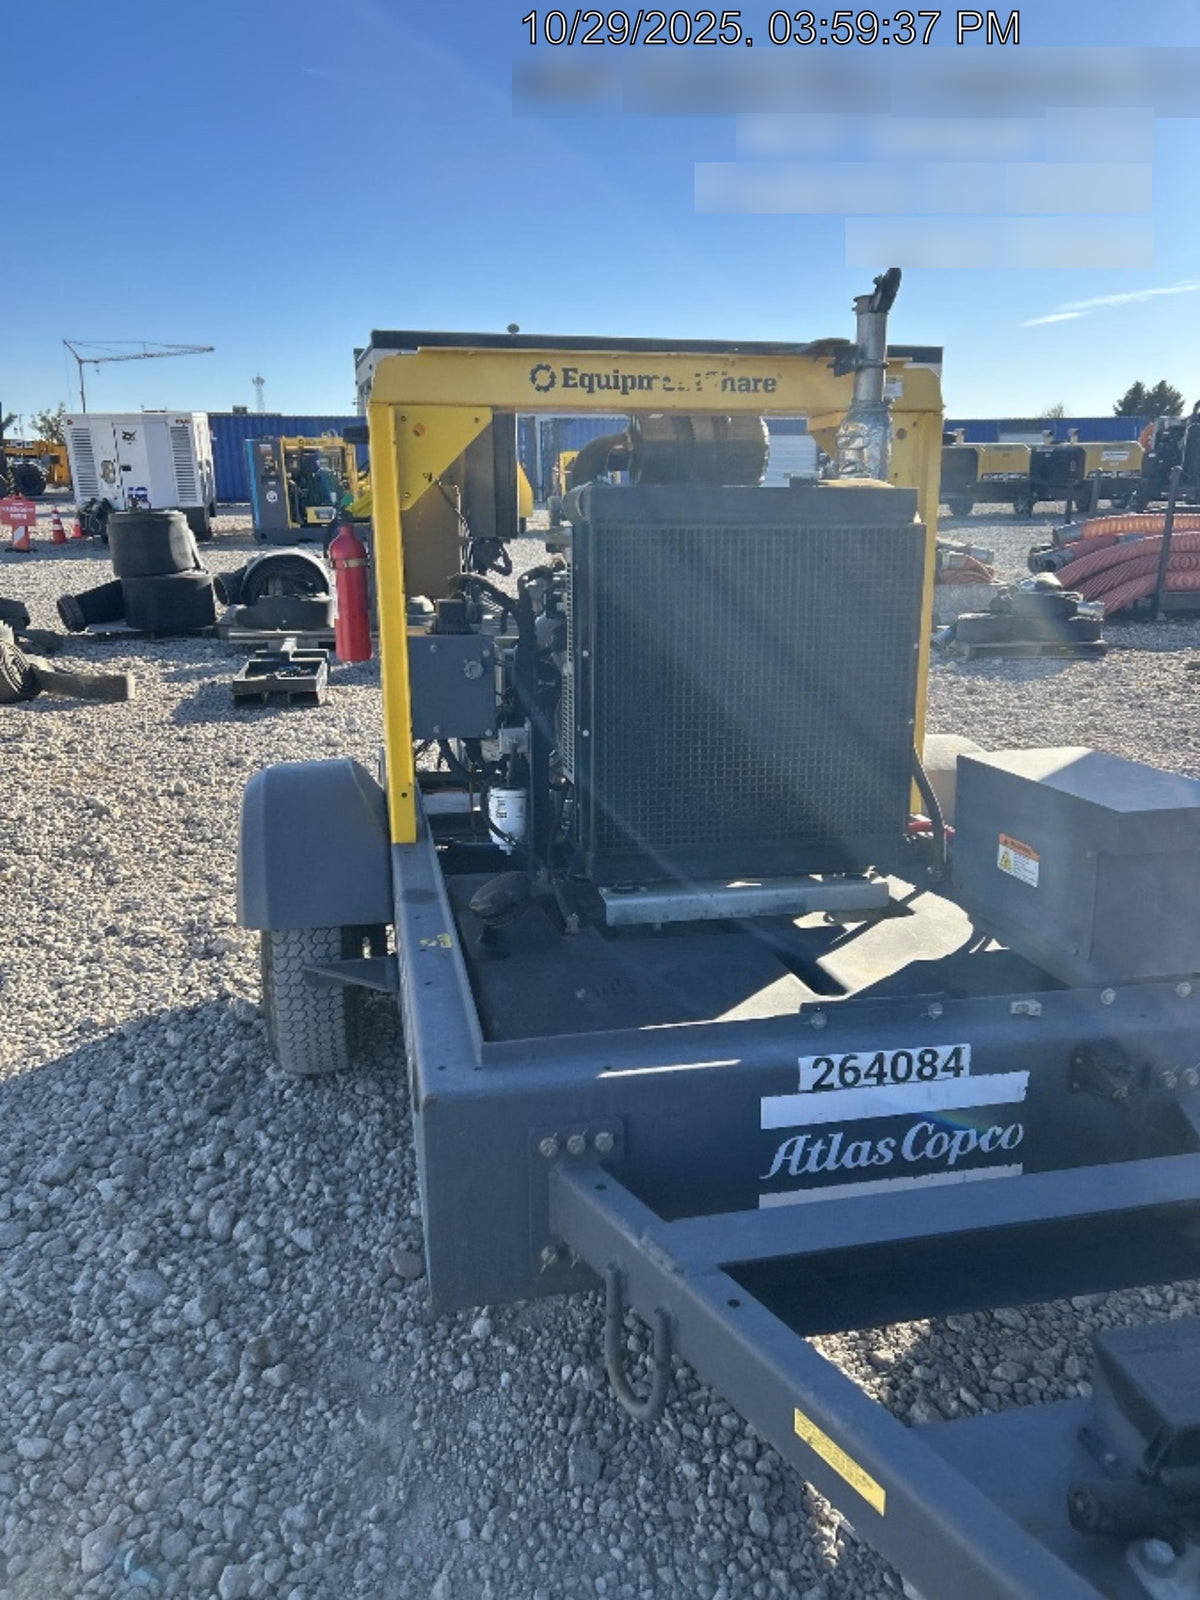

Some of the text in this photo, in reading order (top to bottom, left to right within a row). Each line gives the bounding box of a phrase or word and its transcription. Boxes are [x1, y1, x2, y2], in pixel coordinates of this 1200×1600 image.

[561, 367, 777, 395] Equipmehare
[811, 1046, 964, 1090] 264084
[759, 1121, 1025, 1180] Atlas Copco
